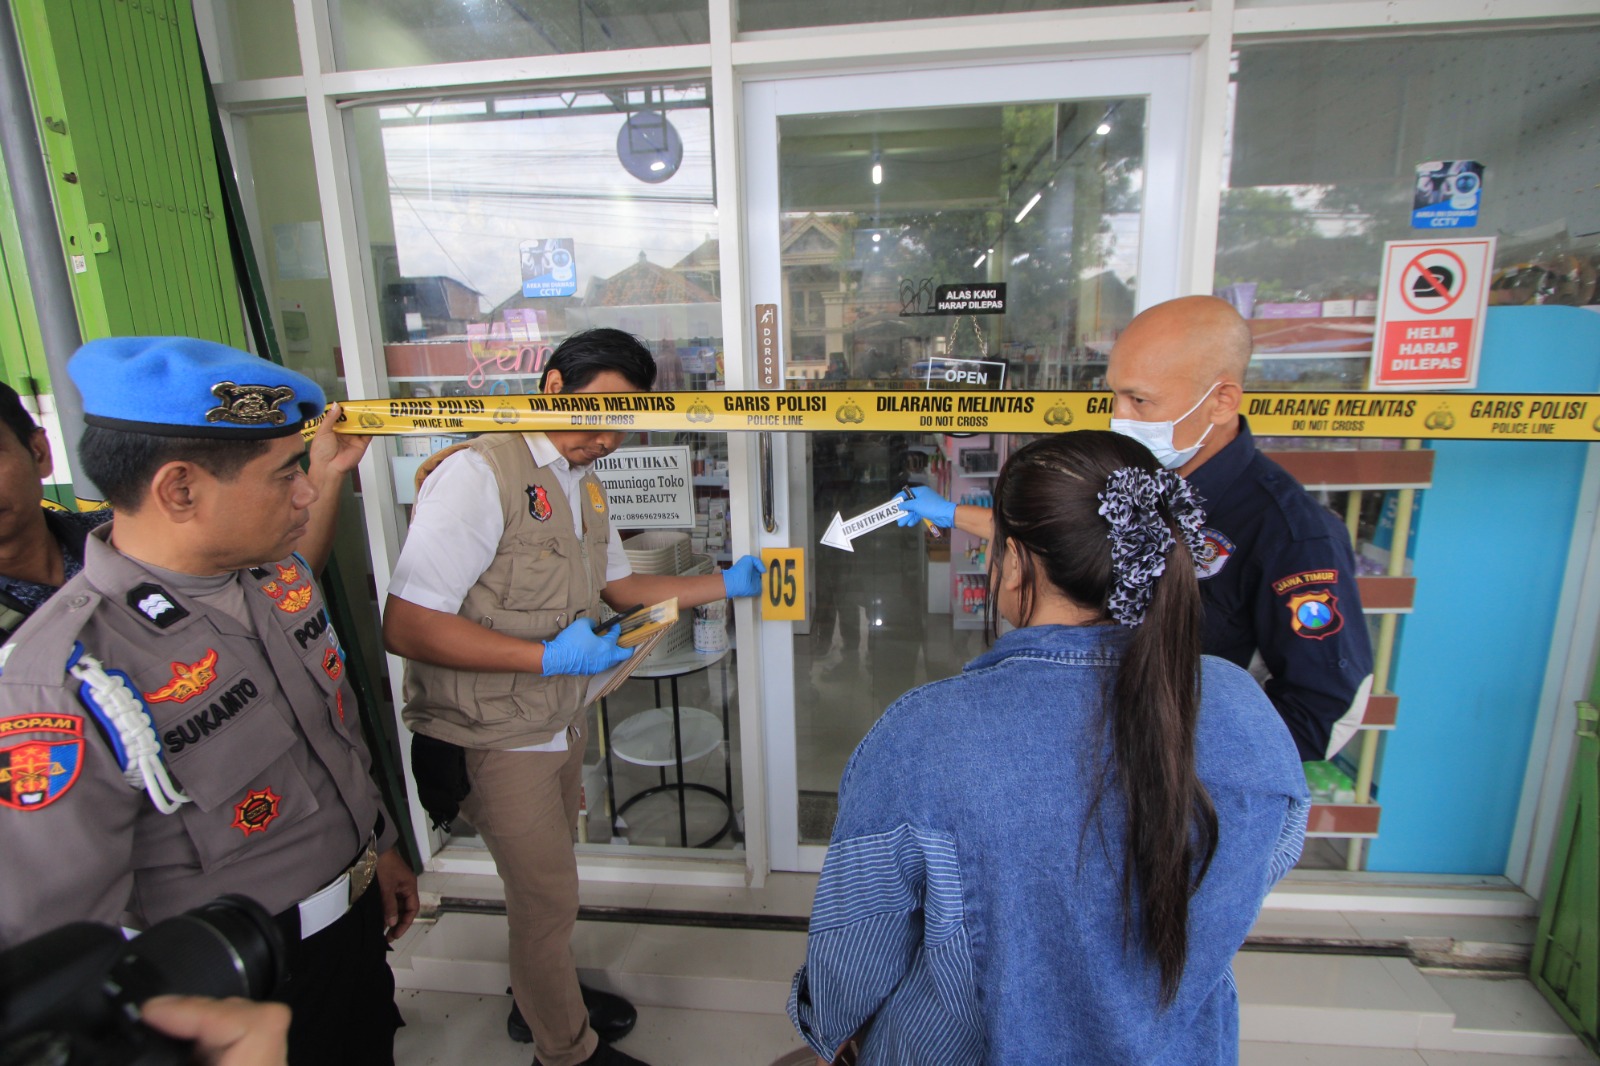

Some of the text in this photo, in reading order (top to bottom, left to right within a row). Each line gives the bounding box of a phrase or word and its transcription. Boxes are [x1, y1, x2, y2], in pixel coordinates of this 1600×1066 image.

[1430, 217, 1459, 227] CCTV
[540, 288, 562, 297] CCTV
[946, 289, 997, 300] ALAS KAKI
[938, 300, 1003, 310] HARAP DILEPAS
[1406, 326, 1455, 340] HELM
[1398, 341, 1458, 355] HARAP
[763, 328, 773, 384] DORONG
[1391, 356, 1462, 371] DILEPAS
[945, 369, 988, 385] OPEN
[390, 399, 485, 417] GARIS POLISI
[528, 396, 675, 411] DILARANG MELINTAS
[724, 396, 826, 411] GARIS POLISI
[876, 396, 1035, 413] DILARANG MELINTAS
[1249, 399, 1416, 417] DILARANG MELINTAS
[1470, 400, 1588, 419] GARIS POLISI
[413, 418, 464, 428] POLICE LINE
[571, 415, 634, 425] DO NOT CROSS
[747, 415, 803, 425] POLICE LINE
[920, 416, 988, 427] DO NOT CROSS
[1292, 420, 1365, 431] DO NOT CROSS
[1492, 422, 1555, 434] POLICE LINE
[594, 456, 678, 470] DIBUTUHKAN
[657, 475, 684, 488] Toko
[608, 494, 677, 504] NNA BEAUTY
[842, 504, 900, 536] IDENTIFIKAS
[769, 558, 796, 607] 05
[1278, 572, 1335, 591] JAWA TIMUR
[164, 678, 258, 753] SUKAMTO
[0, 718, 72, 732] ROPAM
